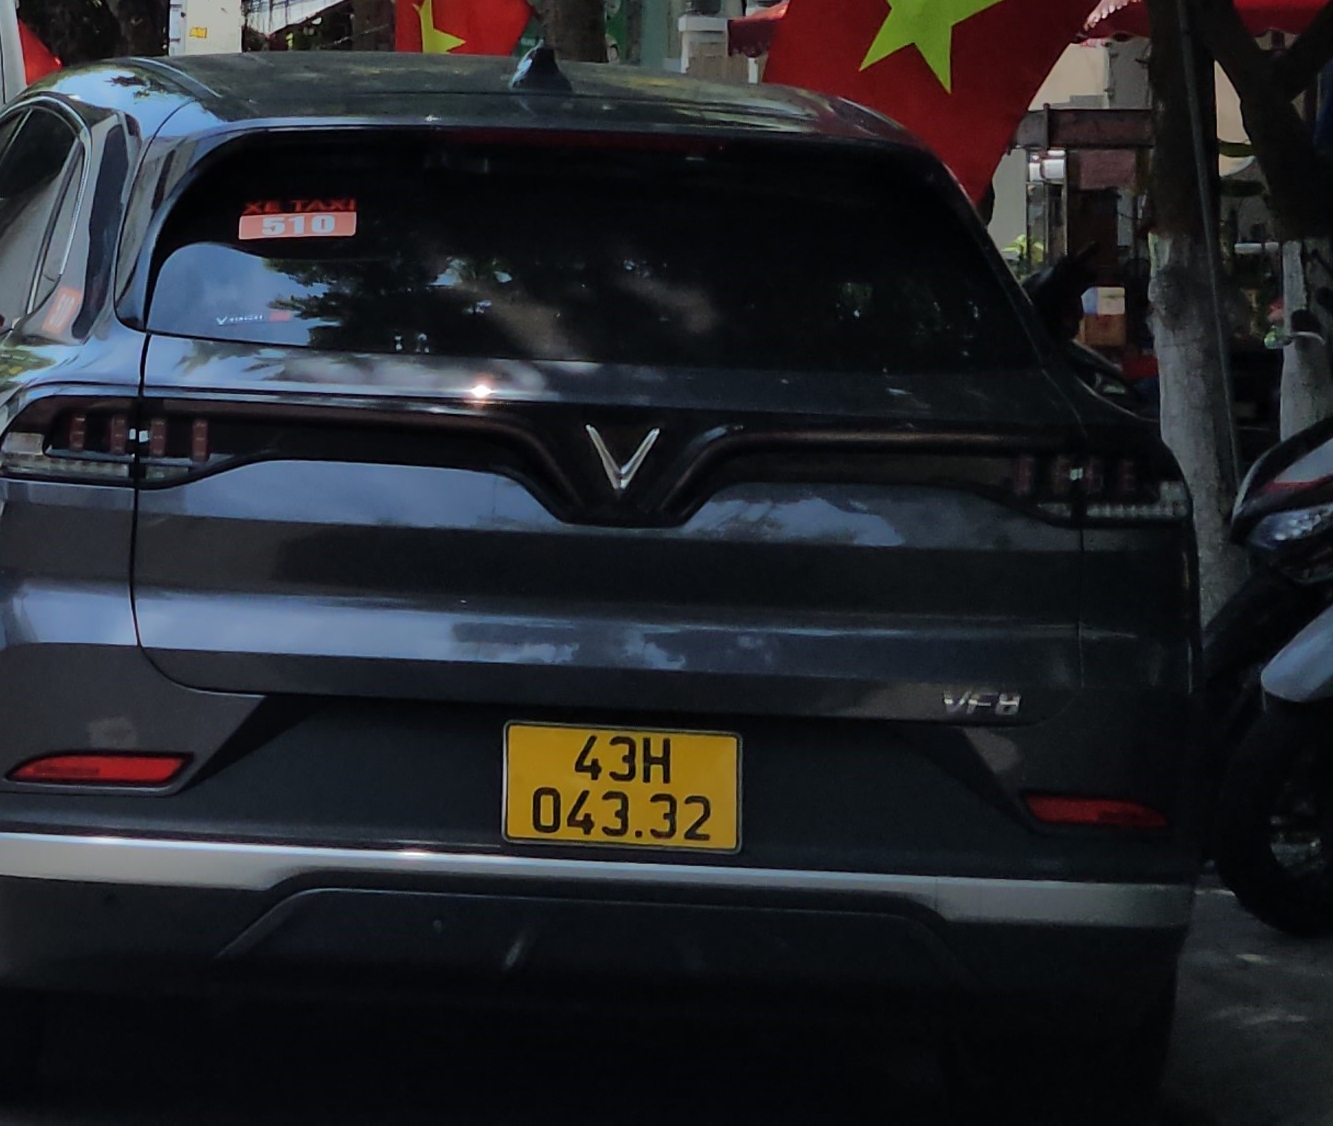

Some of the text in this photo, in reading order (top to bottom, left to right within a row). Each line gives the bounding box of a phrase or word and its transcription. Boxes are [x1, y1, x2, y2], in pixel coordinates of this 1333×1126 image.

[242, 199, 355, 214] XE TAXI
[262, 215, 335, 235] 510
[575, 735, 671, 784] 43H
[533, 787, 711, 842] 043.32
